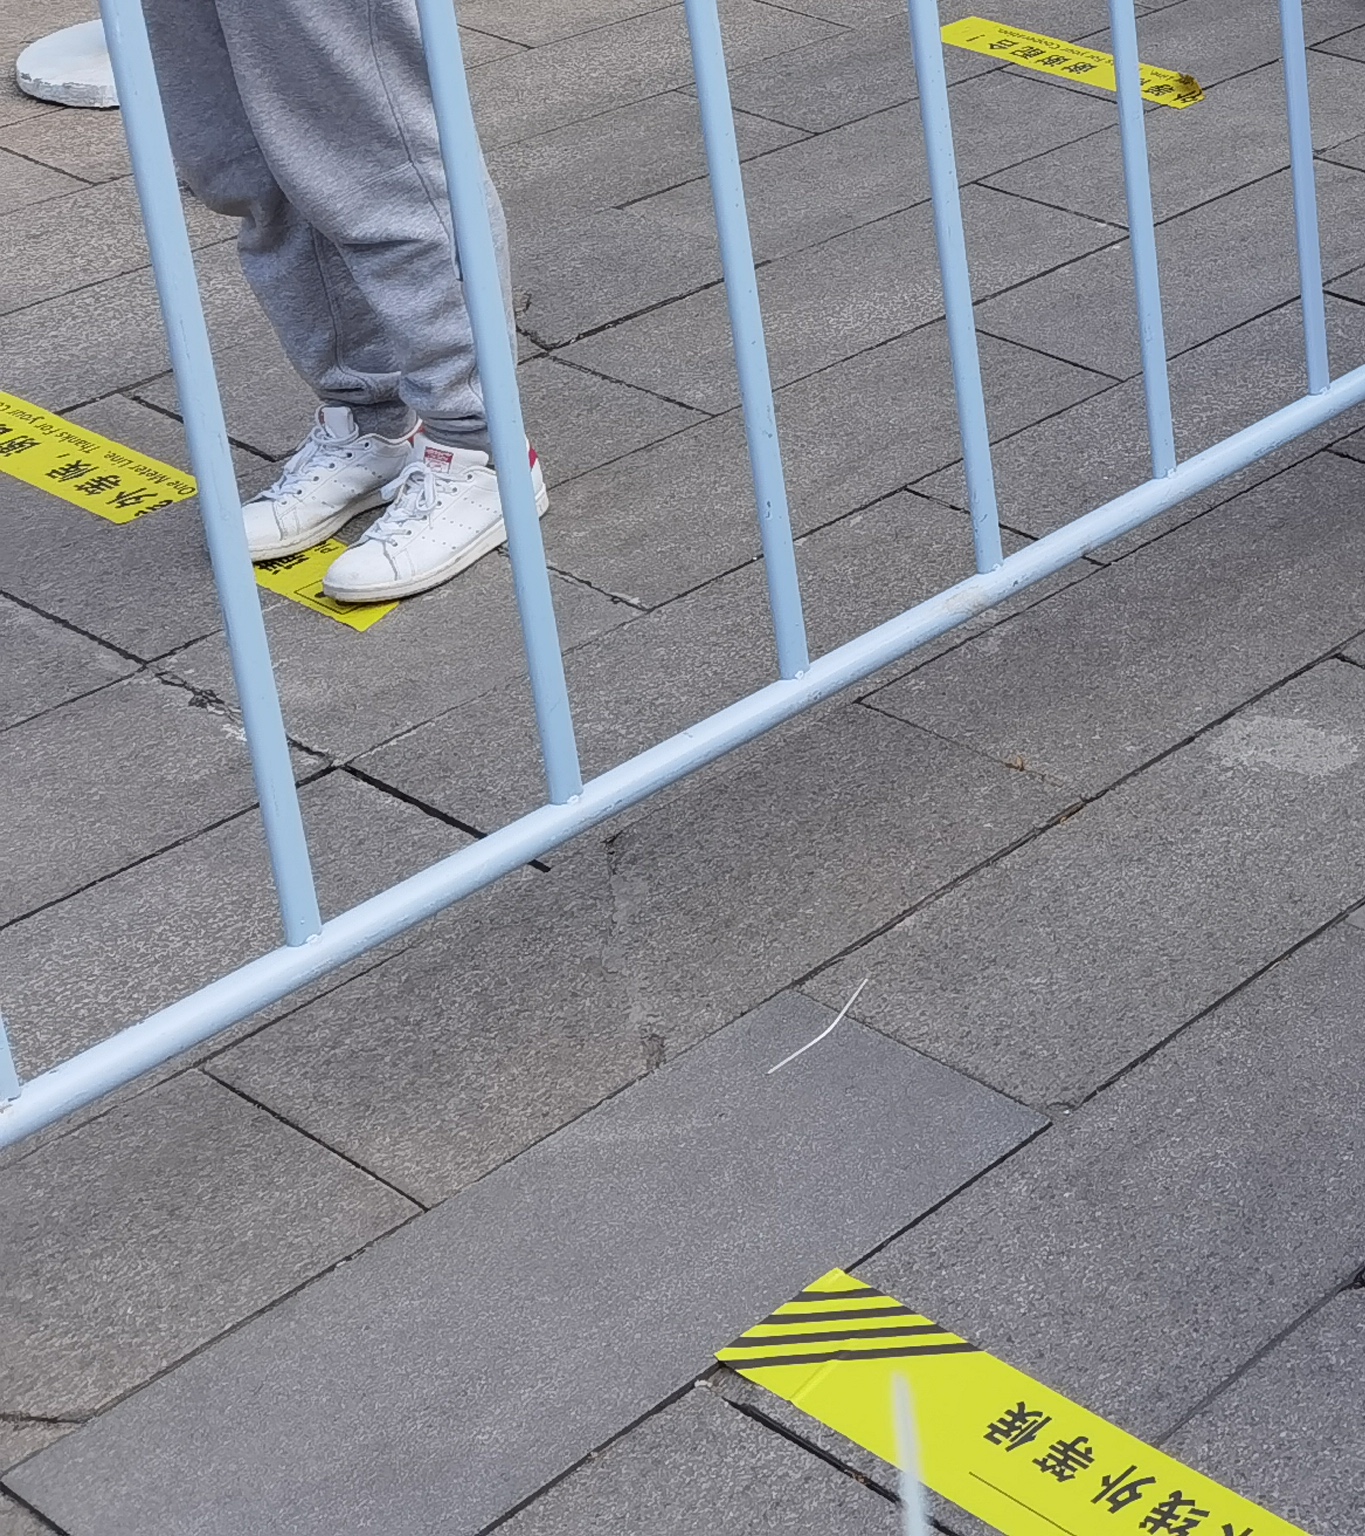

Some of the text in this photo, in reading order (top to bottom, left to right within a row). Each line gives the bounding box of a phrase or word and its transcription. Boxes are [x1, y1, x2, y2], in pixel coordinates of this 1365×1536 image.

[6, 409, 45, 425] your
[54, 430, 101, 454] Thanks
[104, 449, 134, 470] Line.
[136, 460, 170, 485] Meter
[166, 478, 196, 496] One
